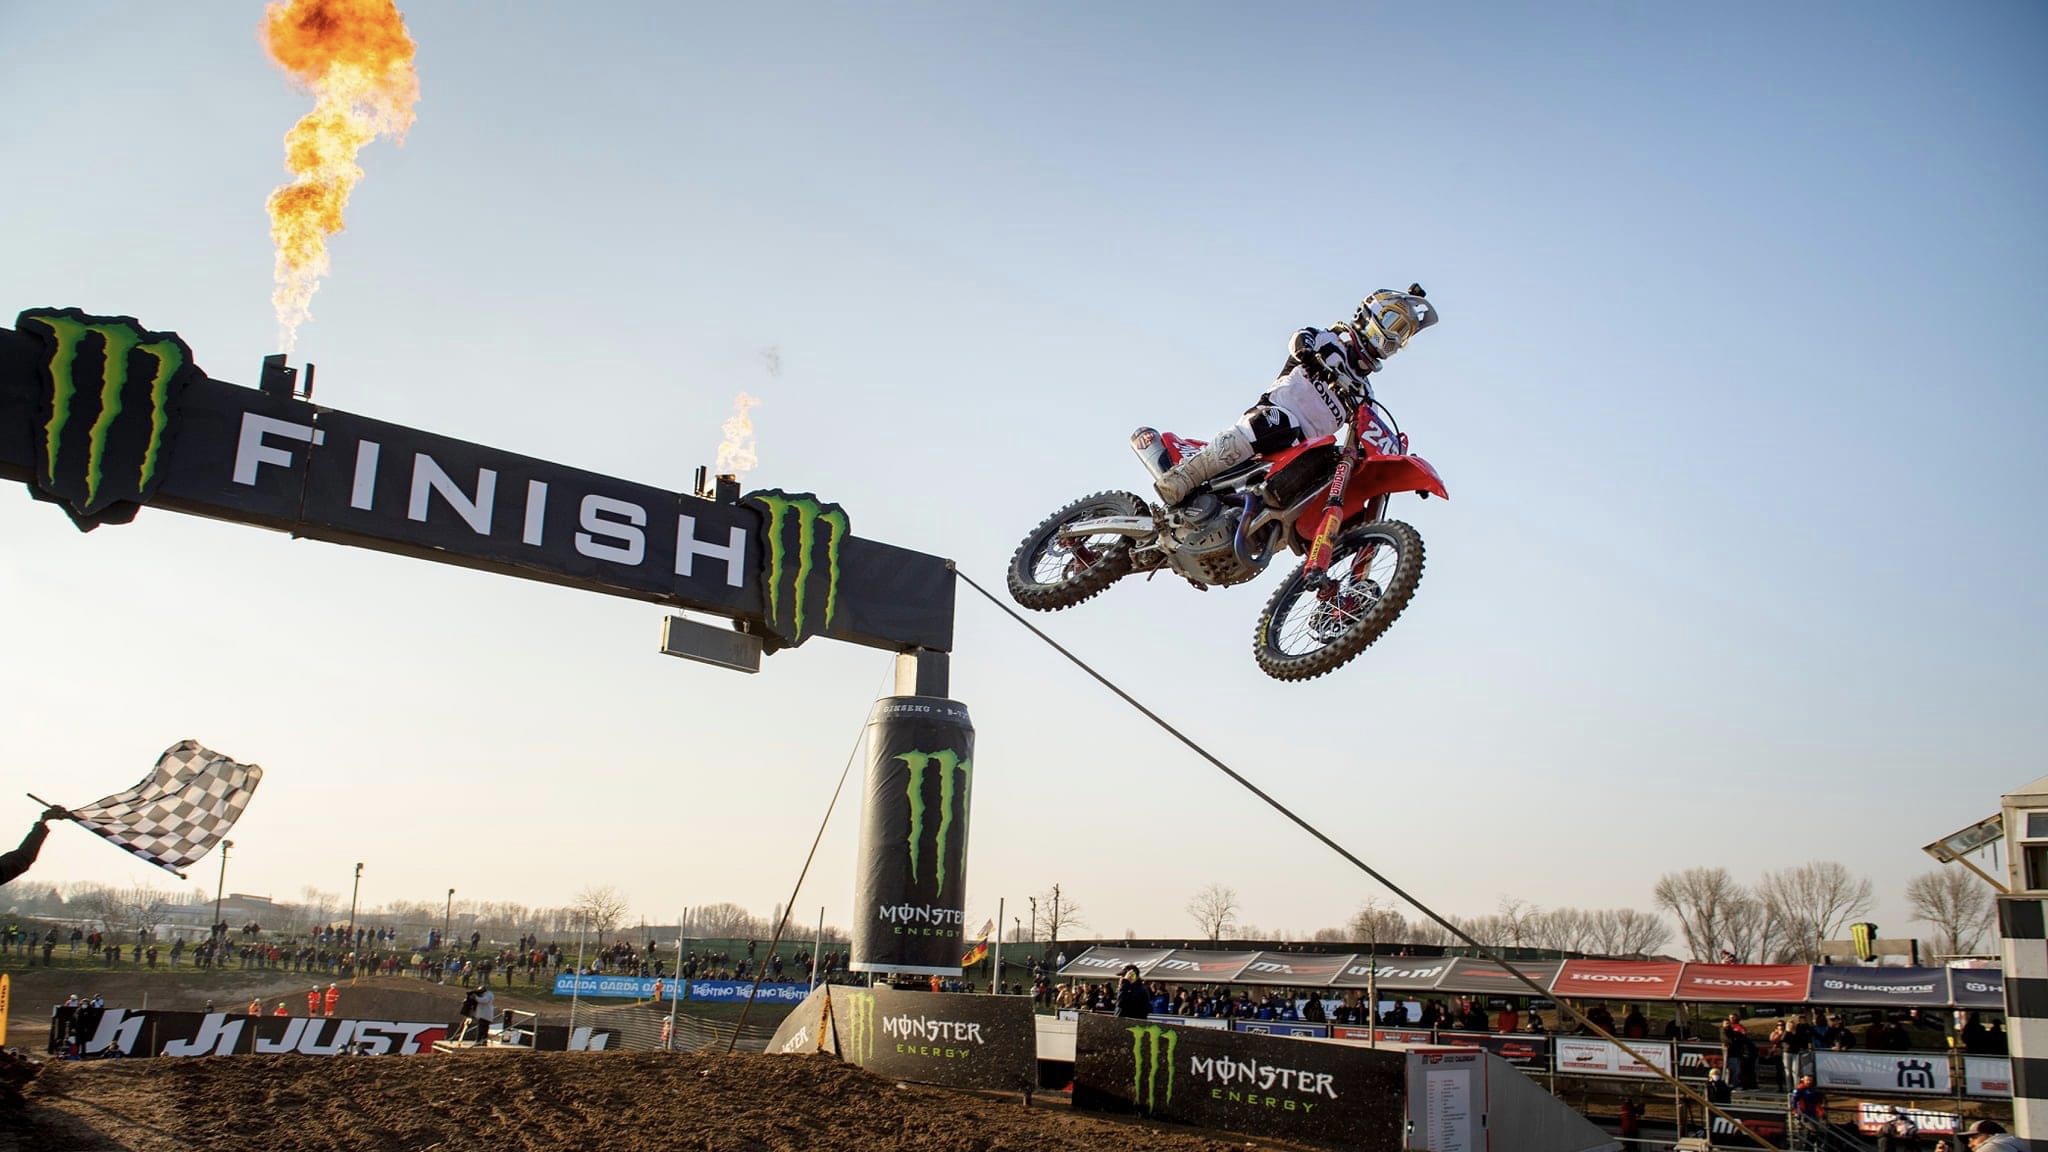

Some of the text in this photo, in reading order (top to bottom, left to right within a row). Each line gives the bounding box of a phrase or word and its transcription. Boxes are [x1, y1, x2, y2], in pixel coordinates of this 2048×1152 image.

[1312, 378, 1344, 427] ONDA
[233, 411, 748, 588] FINISH
[894, 926, 961, 938] ENERGY
[1570, 973, 1665, 984] HONDA
[1693, 977, 1794, 988] HONDA
[600, 981, 639, 992] GARDA
[642, 982, 682, 993] GADA
[692, 983, 734, 997] TRENTINO
[1845, 983, 1936, 994] Husqvarna
[883, 1015, 985, 1045] MONSTER
[896, 1043, 970, 1059] ENERGY
[1191, 1055, 1339, 1100] MONSTER
[1211, 1088, 1316, 1113] ENERGY
